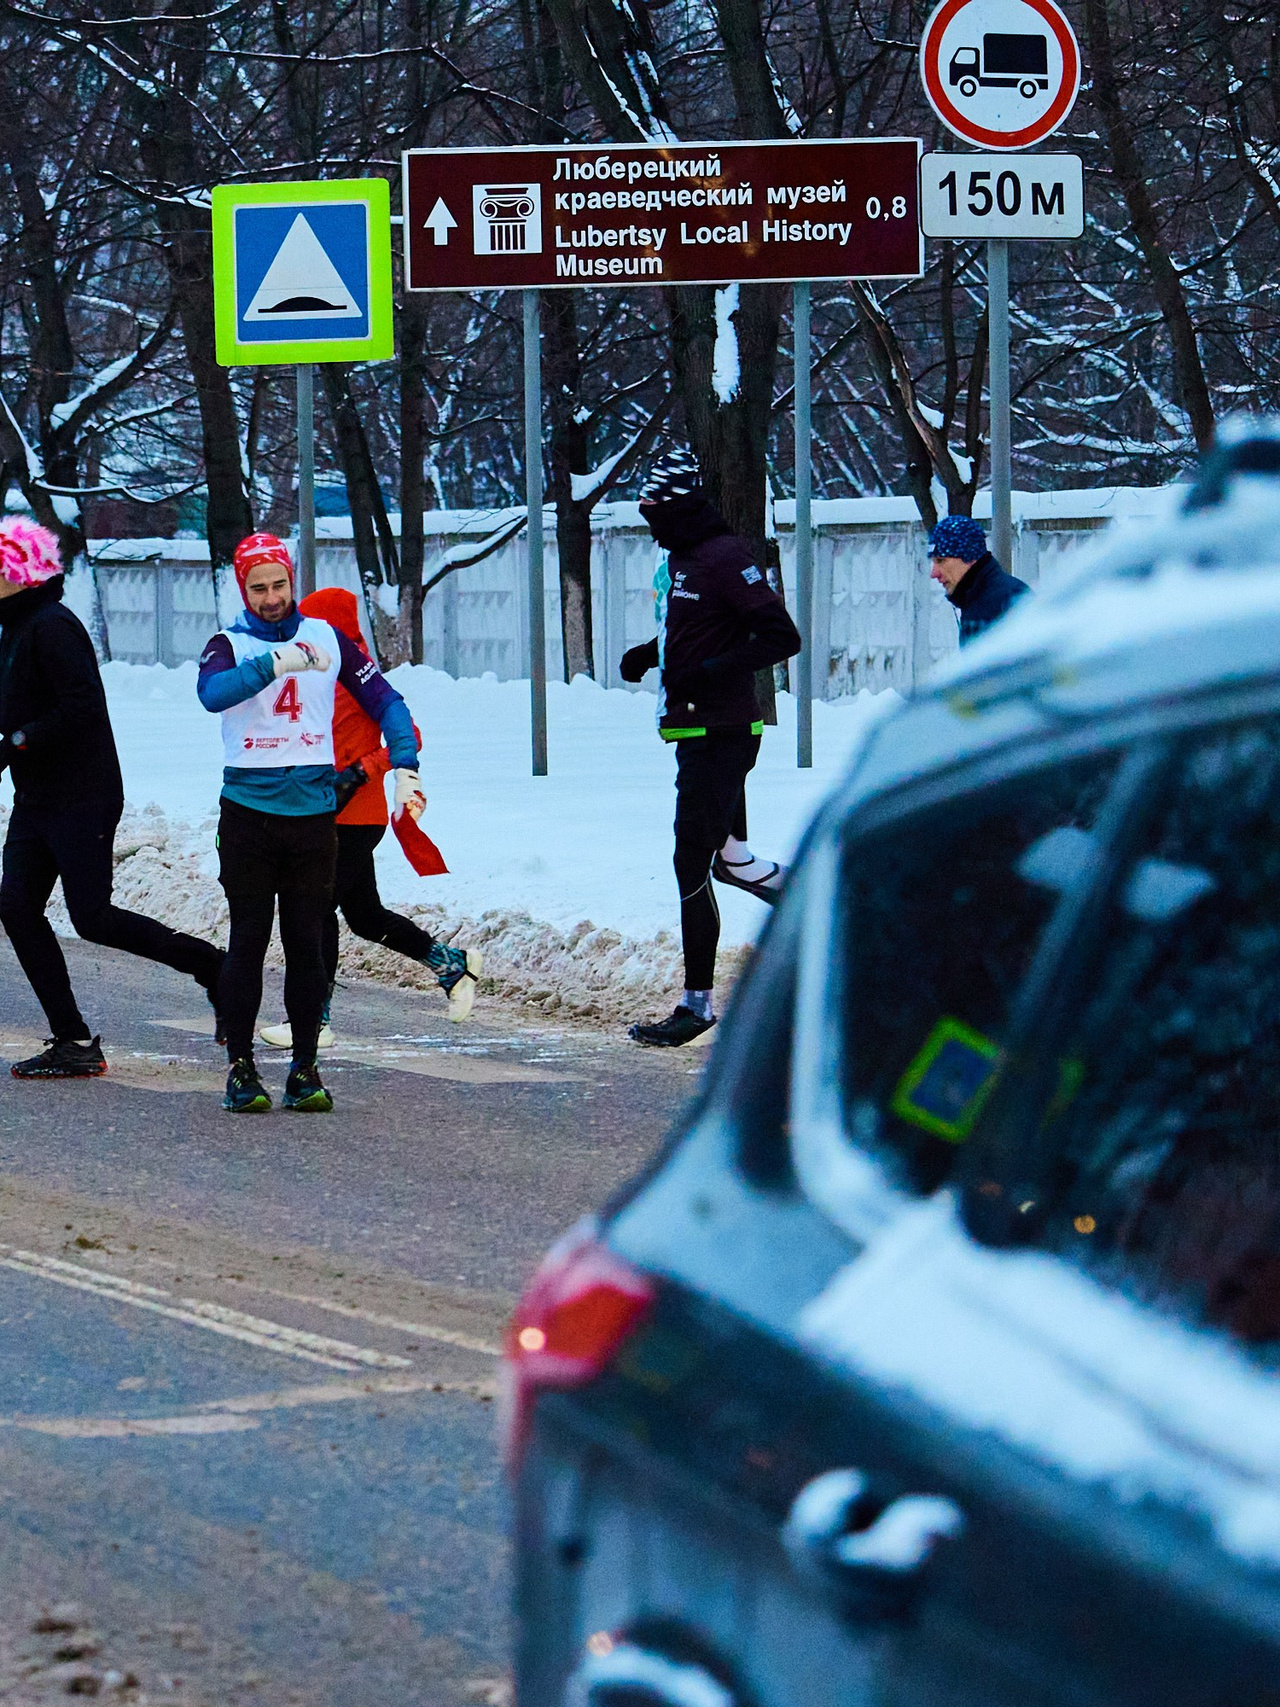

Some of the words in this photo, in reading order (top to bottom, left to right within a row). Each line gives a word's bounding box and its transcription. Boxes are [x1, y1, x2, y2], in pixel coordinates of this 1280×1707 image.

[552, 153, 721, 185] Люберецкий
[554, 181, 753, 216] краеведческий
[766, 179, 847, 210] музей
[865, 196, 908, 222] 0,8
[938, 170, 1022, 217] 150
[555, 224, 667, 251] Lubertsy
[680, 220, 749, 245] Local
[762, 220, 853, 247] History
[555, 254, 664, 277] Museum
[273, 676, 303, 723] 4
